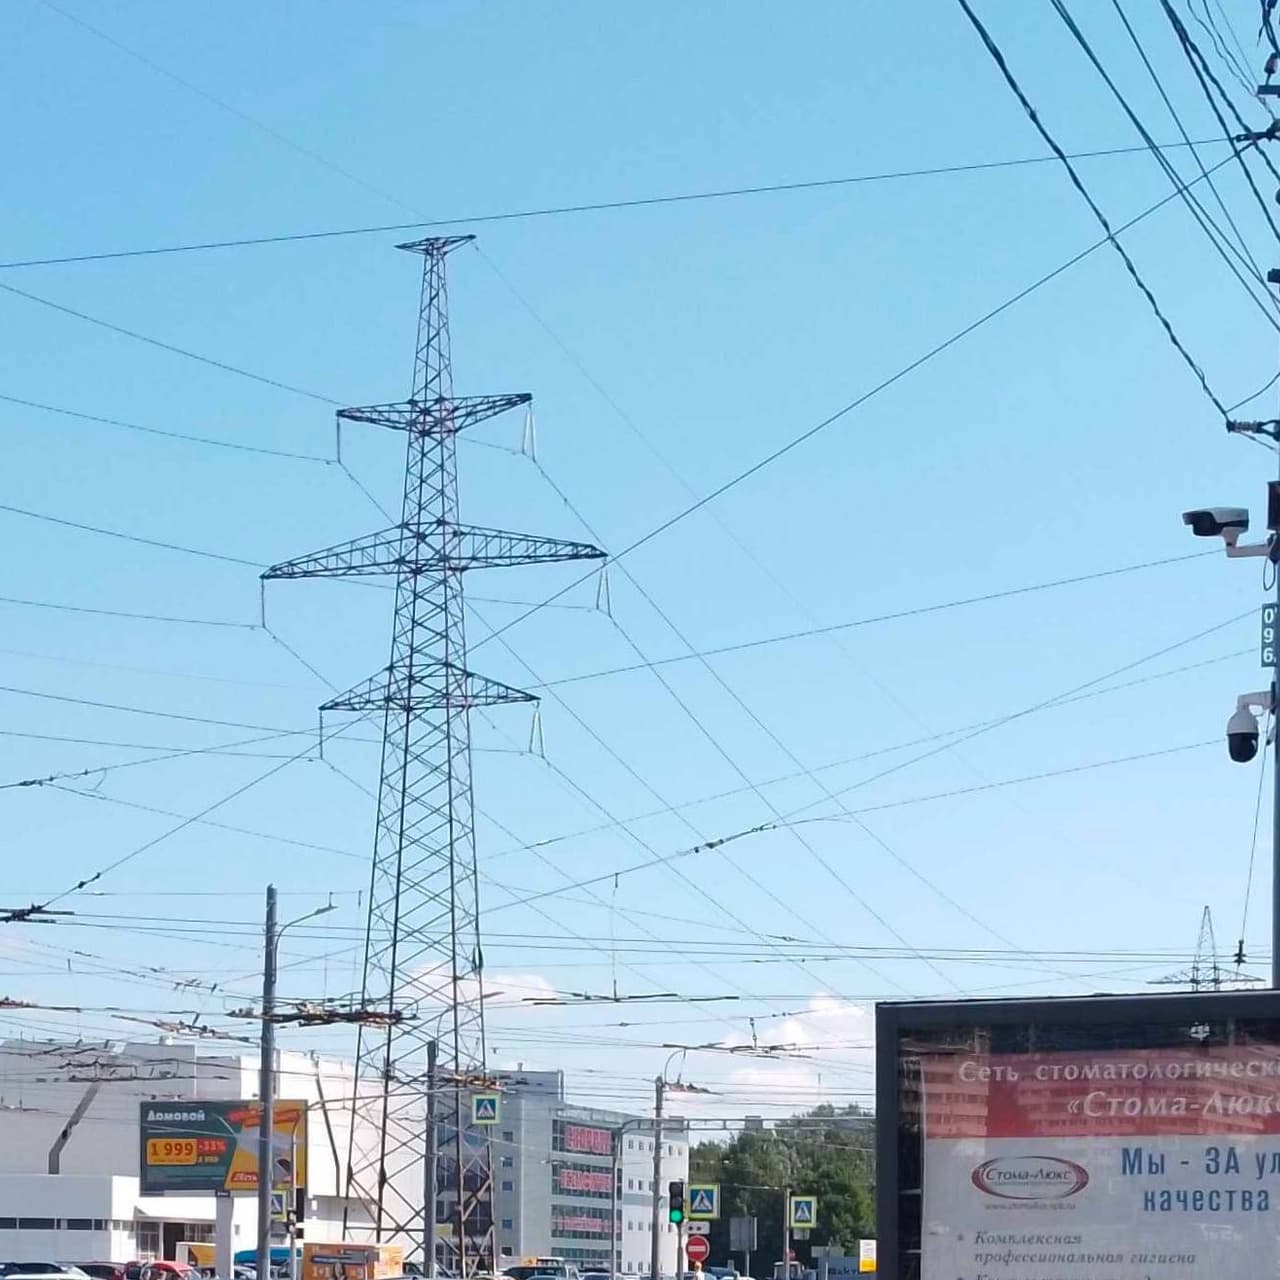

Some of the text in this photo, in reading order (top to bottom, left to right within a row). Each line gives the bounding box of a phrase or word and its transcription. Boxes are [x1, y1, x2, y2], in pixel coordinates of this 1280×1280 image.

[959, 1061, 1019, 1083] Сеть
[1122, 1147, 1166, 1176] Мы
[1205, 1147, 1240, 1175] ЗА
[1144, 1188, 1269, 1213] качества
[974, 1231, 1082, 1245] Комплексная
[974, 1250, 1196, 1266] профессиональная гигиена
